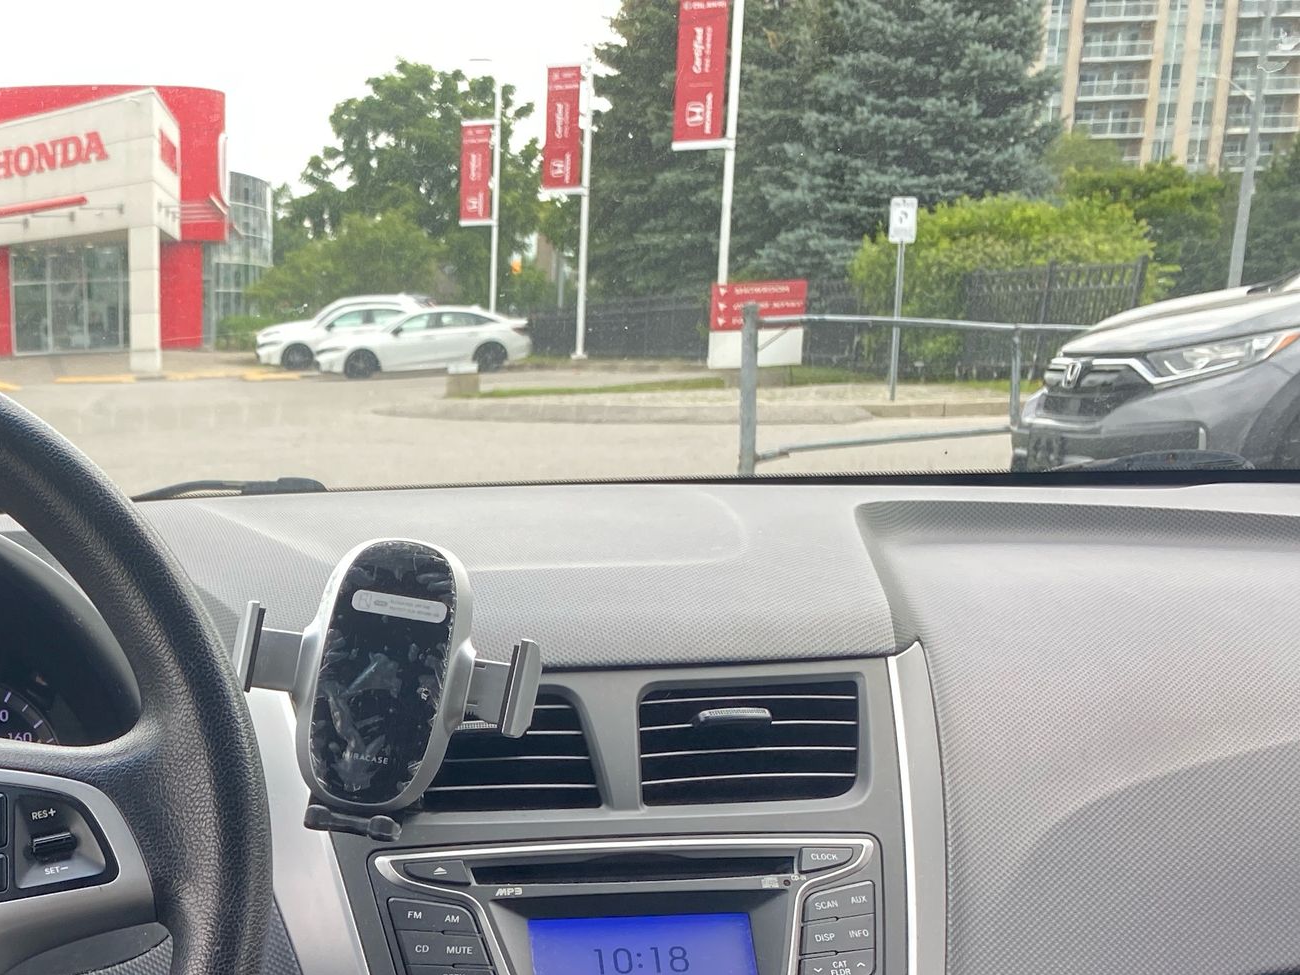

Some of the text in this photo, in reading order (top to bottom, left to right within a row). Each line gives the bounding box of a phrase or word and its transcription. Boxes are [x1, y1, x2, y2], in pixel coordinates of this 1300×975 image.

[810, 853, 838, 861] CLOCK
[495, 887, 523, 897] MP3
[850, 895, 868, 904] AUX
[815, 900, 839, 910] SCAN
[407, 910, 423, 919] FM
[444, 914, 460, 923] AM
[814, 932, 836, 943] DISP
[849, 929, 870, 938] INFO
[415, 944, 430, 953] CD
[446, 946, 473, 955] MUTE
[594, 946, 690, 975] 10:18
[832, 960, 848, 969] CAT
